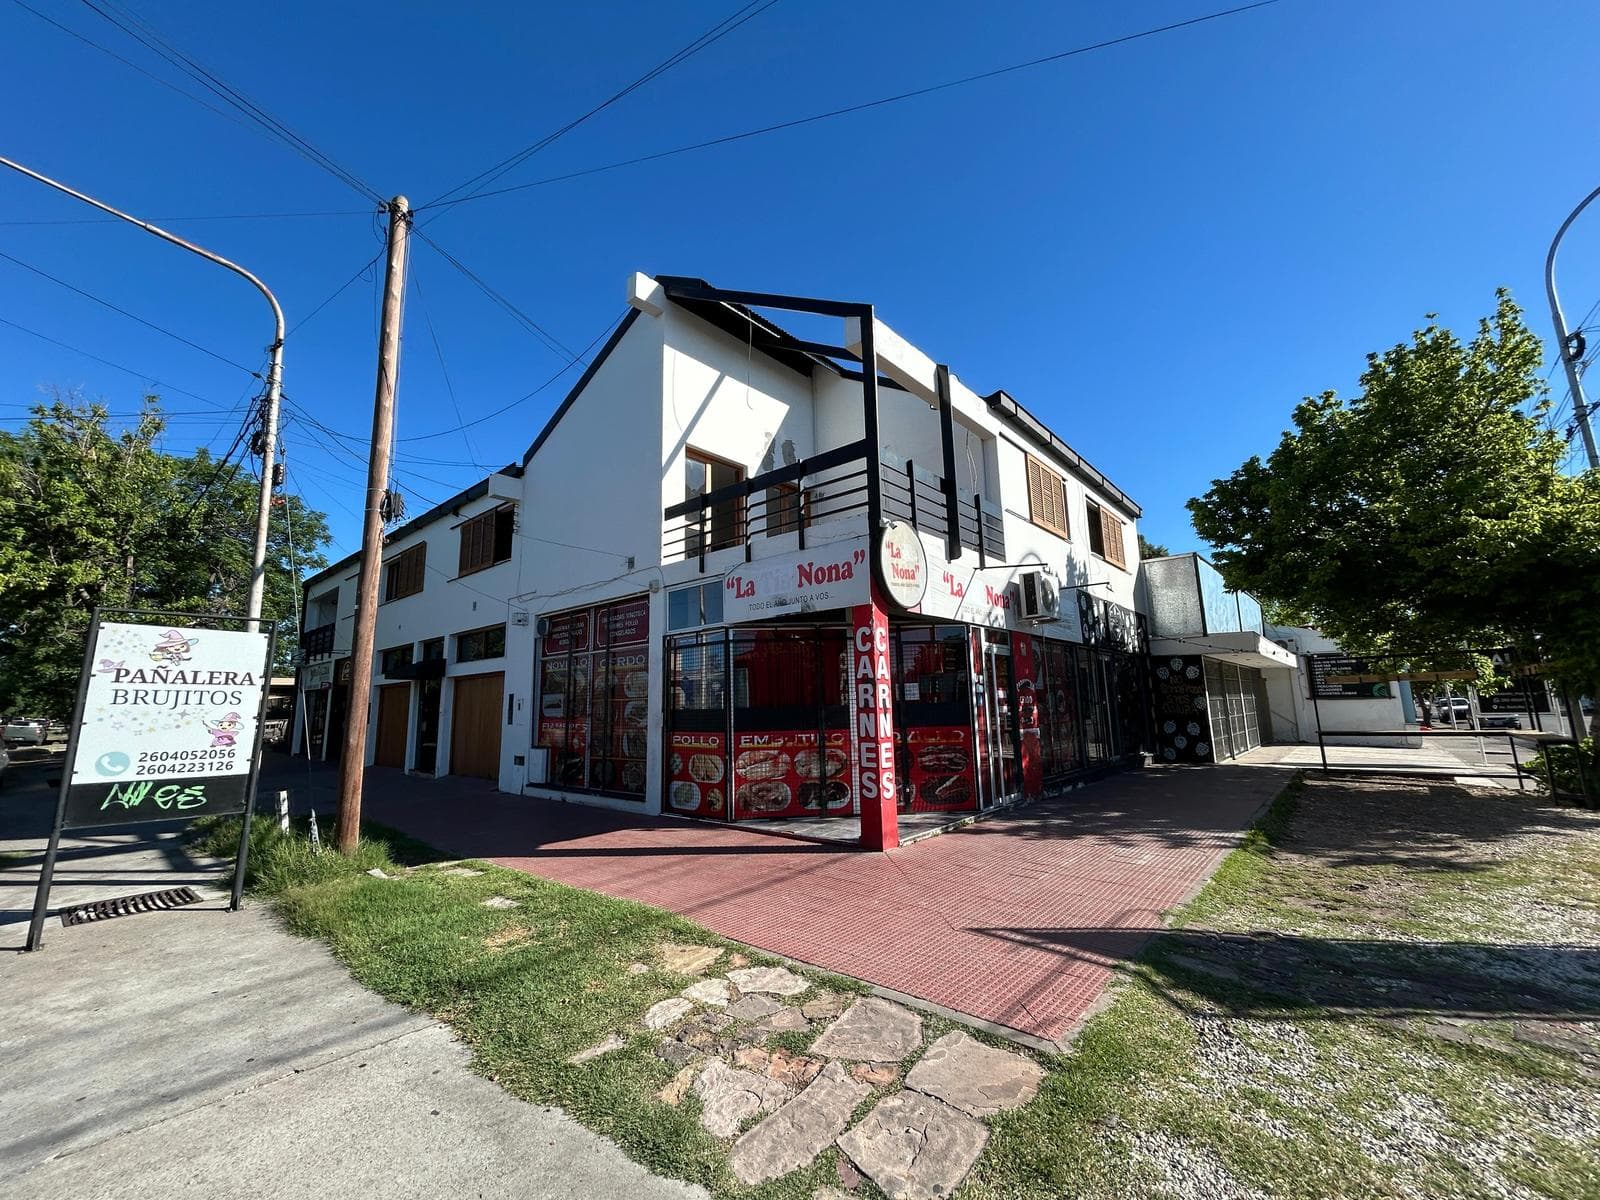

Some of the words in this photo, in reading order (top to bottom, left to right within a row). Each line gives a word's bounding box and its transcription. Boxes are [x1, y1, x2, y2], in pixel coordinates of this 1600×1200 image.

[749, 602, 765, 611] TODO
[788, 595, 808, 606] JUNTO
[809, 593, 815, 601] A
[546, 658, 588, 671] NOVILO
[110, 665, 256, 686] PAÑALERA
[110, 688, 243, 710] BRUJITOS
[856, 626, 878, 799] CARNES
[876, 626, 895, 800] CARNES
[672, 735, 720, 746] POLLO
[139, 749, 236, 763] 2604052056
[136, 760, 234, 775] 2604223126
